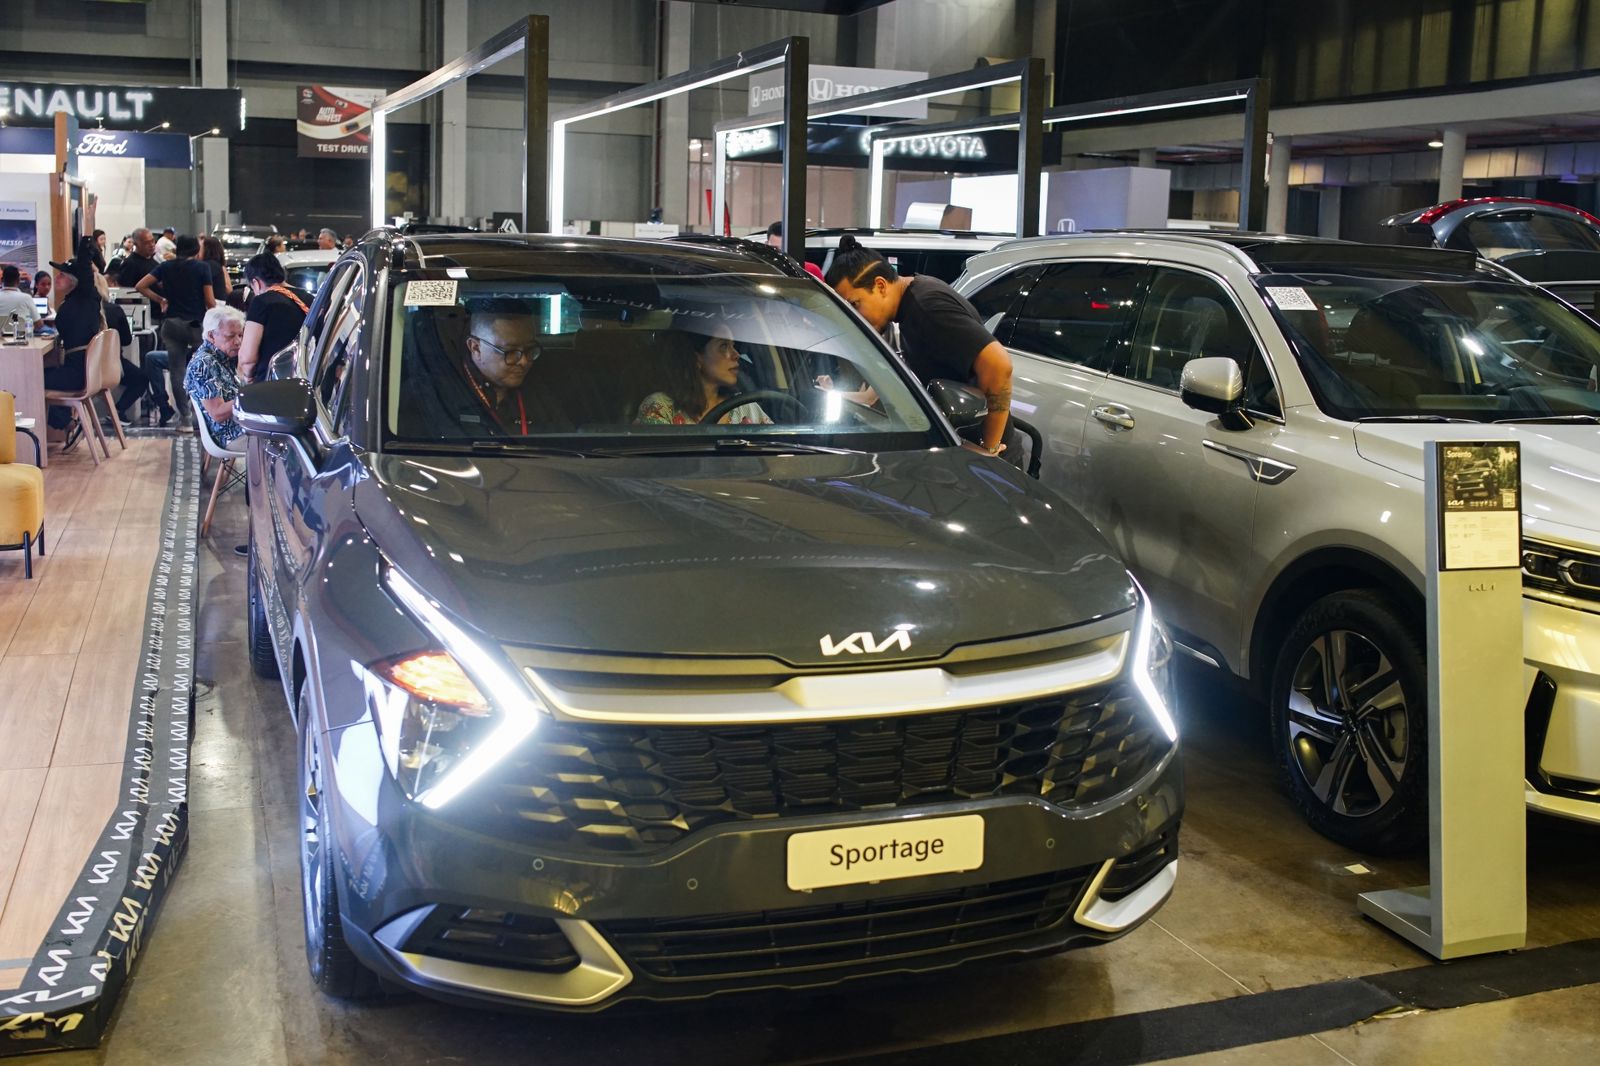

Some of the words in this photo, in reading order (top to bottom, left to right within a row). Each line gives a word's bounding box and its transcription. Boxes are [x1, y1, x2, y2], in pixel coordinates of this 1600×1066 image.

[76, 133, 128, 155] Ford
[317, 143, 340, 153] TEST
[341, 145, 368, 154] DRIVE
[898, 134, 988, 159] TOYOTA
[829, 838, 945, 870] Sportage
